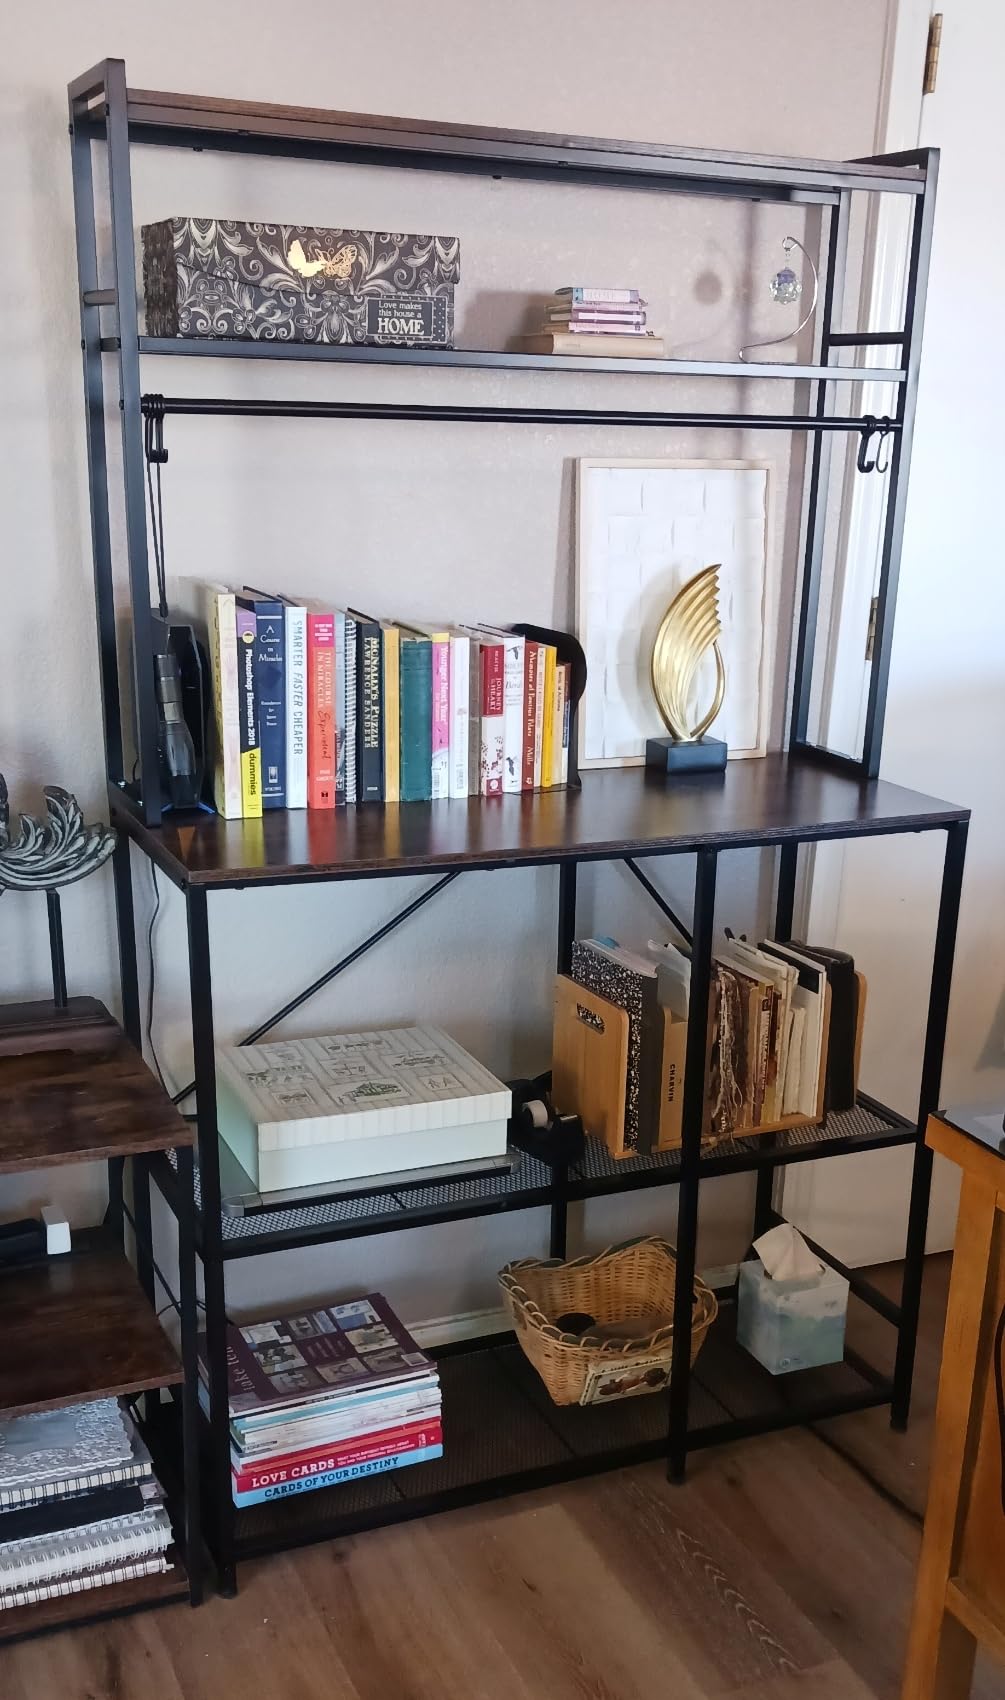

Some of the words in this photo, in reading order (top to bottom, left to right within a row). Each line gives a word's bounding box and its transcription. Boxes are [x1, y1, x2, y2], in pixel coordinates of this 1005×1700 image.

[378, 300, 397, 308] Love
[399, 302, 422, 310] makes
[378, 309, 392, 317] this
[393, 310, 416, 318] house
[377, 317, 425, 335] HOME
[265, 625, 275, 634] A
[292, 620, 303, 667] SMARTER
[244, 648, 254, 691] Photoshop
[439, 645, 449, 681] Younger
[528, 650, 537, 683] Memoirs
[293, 671, 304, 708] FASTER
[440, 682, 449, 703] Next
[489, 684, 497, 711] HEART
[246, 692, 255, 727] Elements
[370, 705, 380, 748] PUZZLE
[440, 703, 449, 722] Year
[293, 710, 304, 755] CHEAPER
[248, 752, 258, 796] dummies
[668, 1063, 676, 1102] CHARVIN
[251, 1471, 287, 1488] LOVE
[290, 1458, 335, 1478] CARDS
[264, 1482, 303, 1498] CARDS
[304, 1477, 319, 1489] OF
[320, 1469, 350, 1485] YOUR
[350, 1456, 399, 1476] DESTINY
